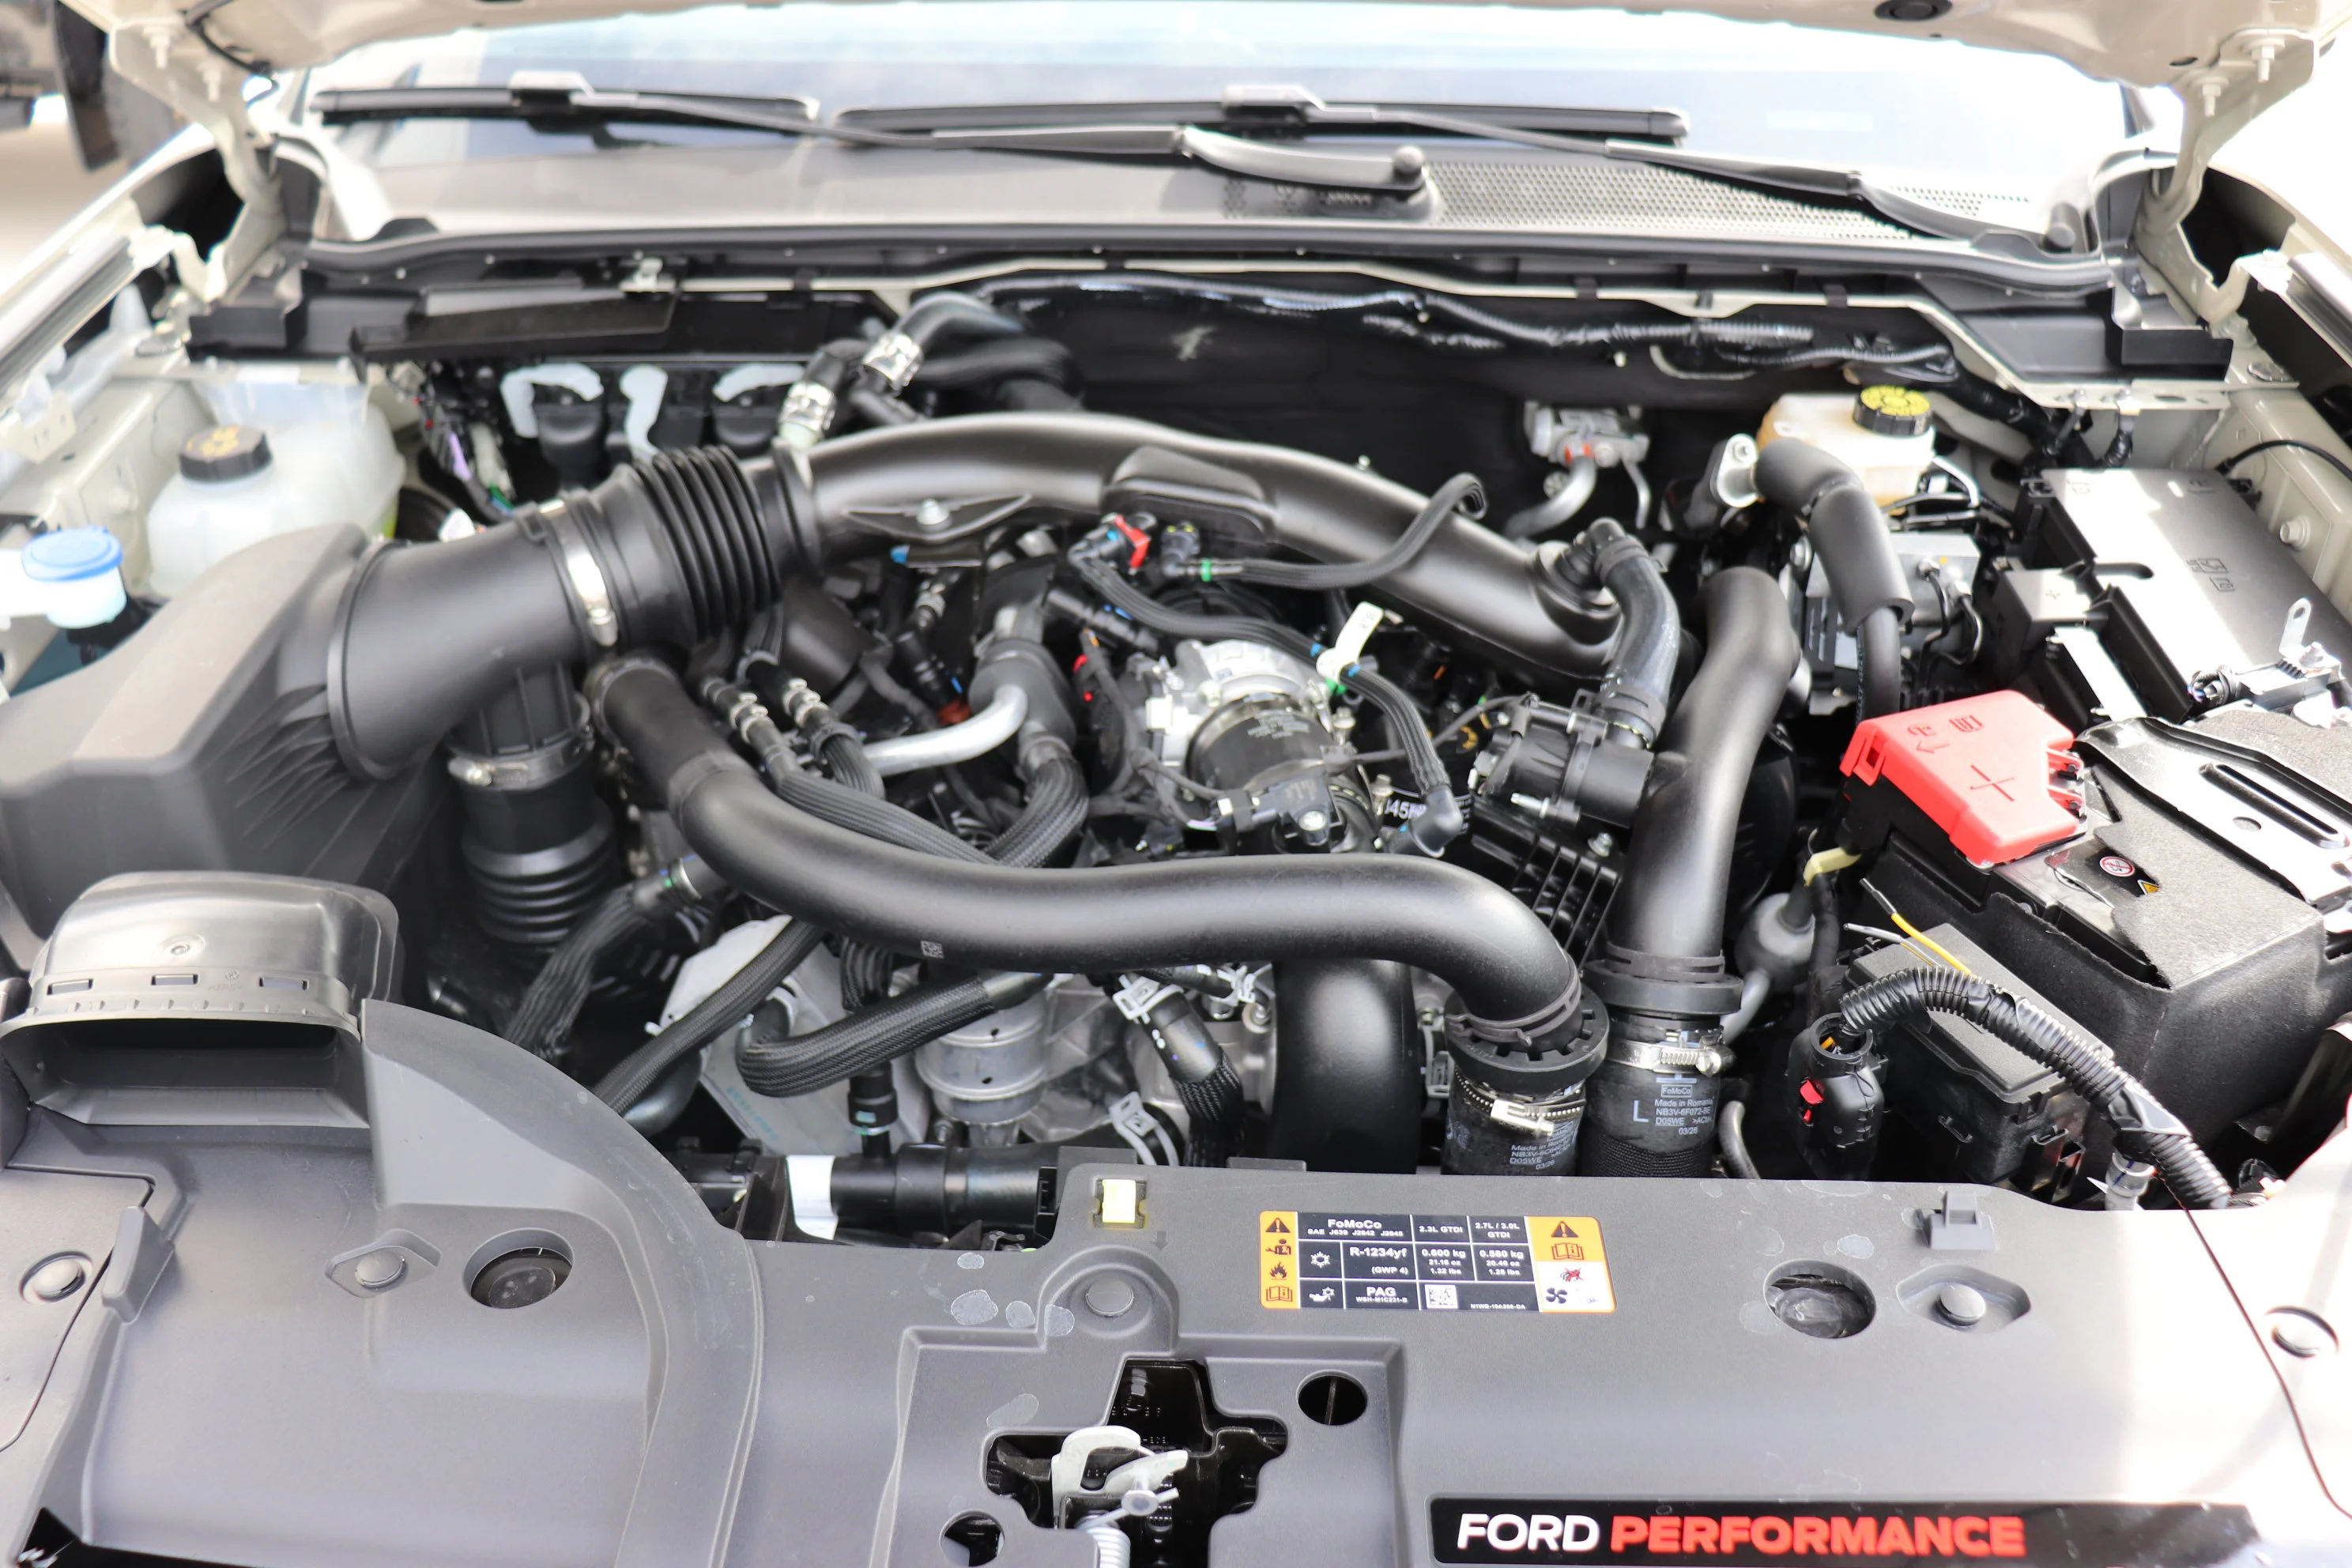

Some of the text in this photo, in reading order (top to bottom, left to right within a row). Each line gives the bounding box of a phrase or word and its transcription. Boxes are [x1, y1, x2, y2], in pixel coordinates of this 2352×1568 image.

[1662, 1087, 1690, 1095] FoMoCo
[1327, 1219, 1382, 1229] FoMoCo
[1349, 1246, 1408, 1259] R-1234yf
[1452, 1249, 1466, 1259] kg
[1510, 1250, 1524, 1260] kg
[1366, 1286, 1396, 1297] PAG
[1454, 1512, 2026, 1557] FORD PERFORMANCE
